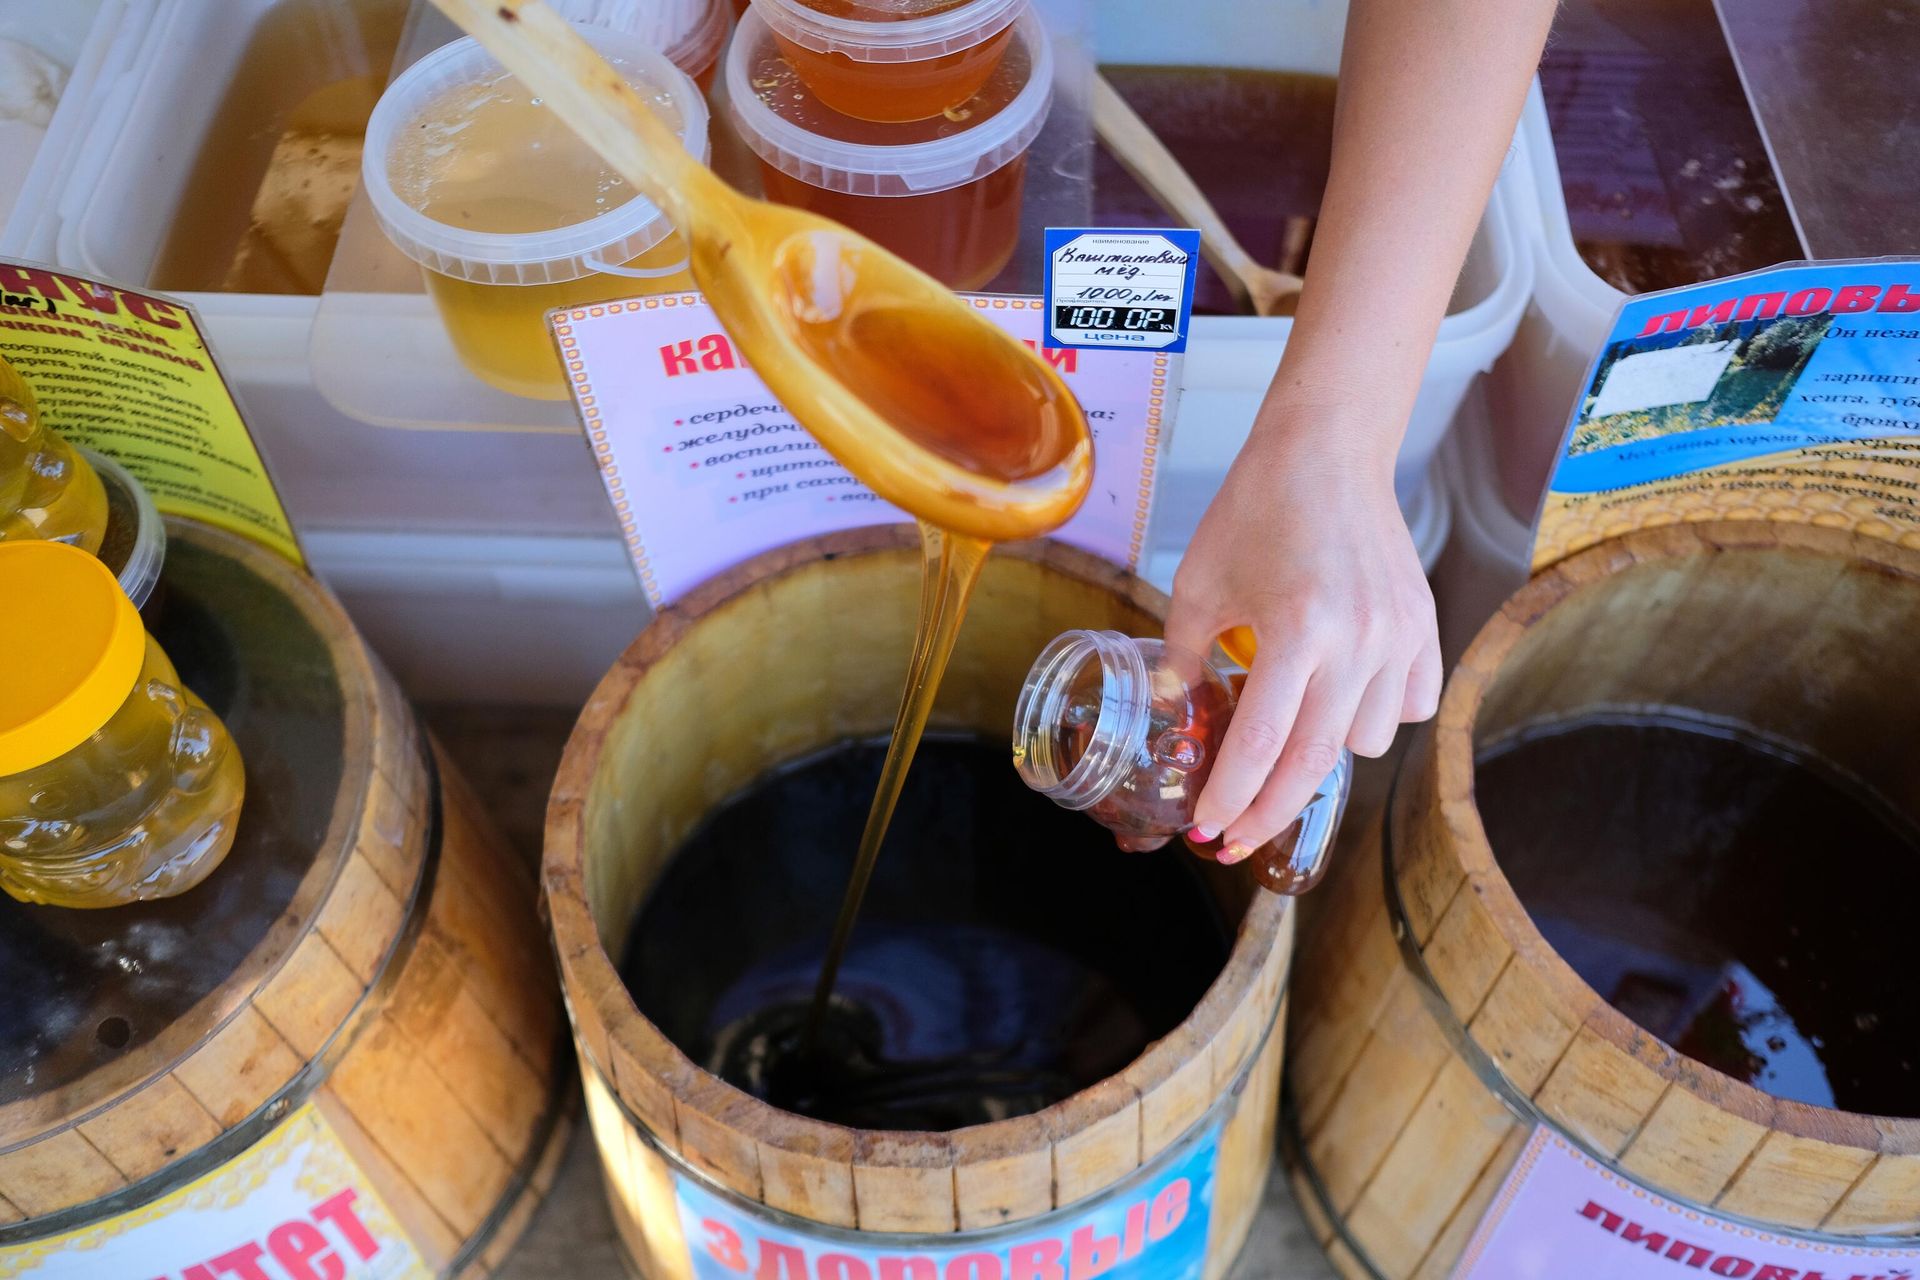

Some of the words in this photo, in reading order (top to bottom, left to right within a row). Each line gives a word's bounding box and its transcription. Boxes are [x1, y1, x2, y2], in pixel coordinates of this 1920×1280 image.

[1084, 333, 1145, 342] цена
[1824, 327, 1858, 338] Он
[742, 482, 790, 502] при
